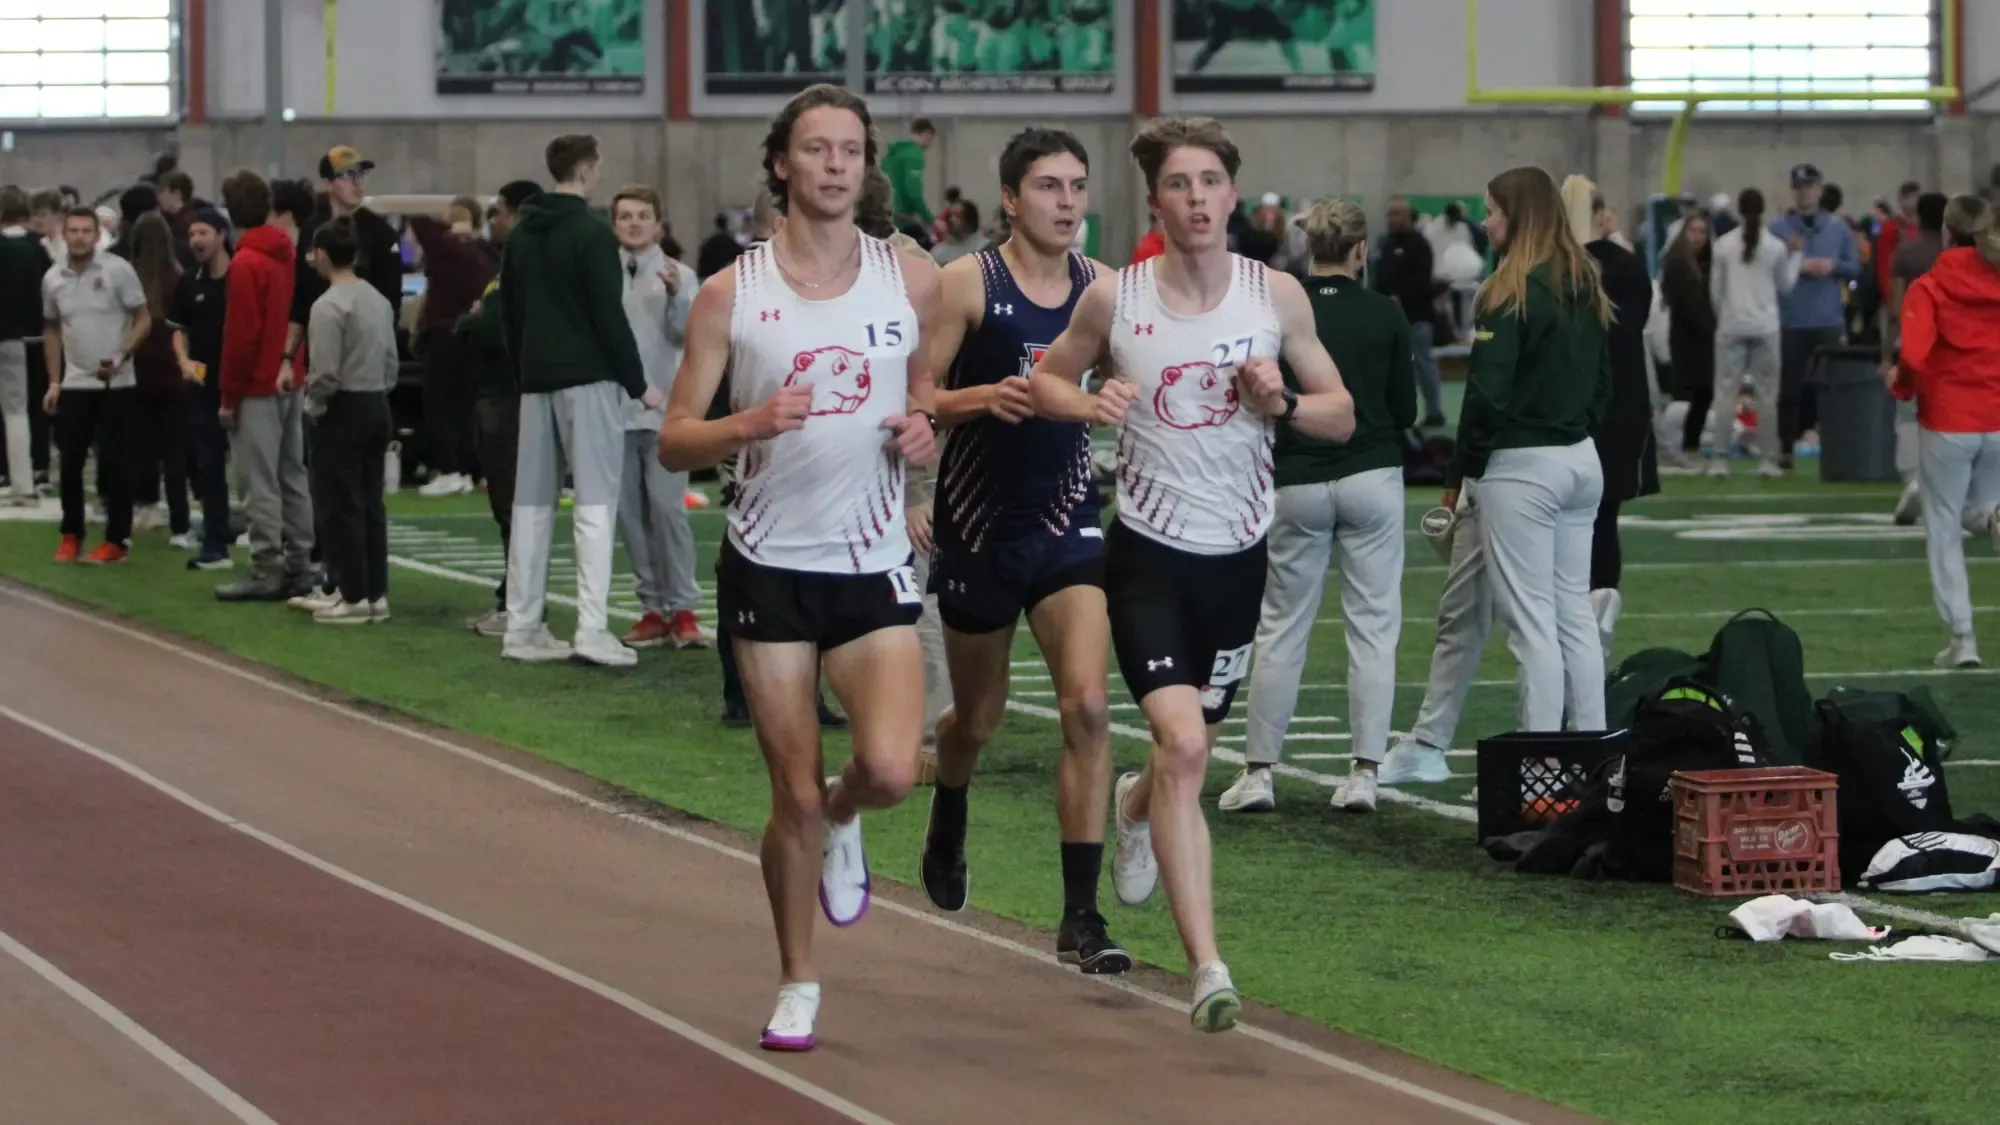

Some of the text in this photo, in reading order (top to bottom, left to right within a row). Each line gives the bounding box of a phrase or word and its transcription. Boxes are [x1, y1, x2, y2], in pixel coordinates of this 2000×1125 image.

[864, 320, 902, 347] 15
[1211, 336, 1253, 369] 27
[1212, 648, 1246, 676] 27
